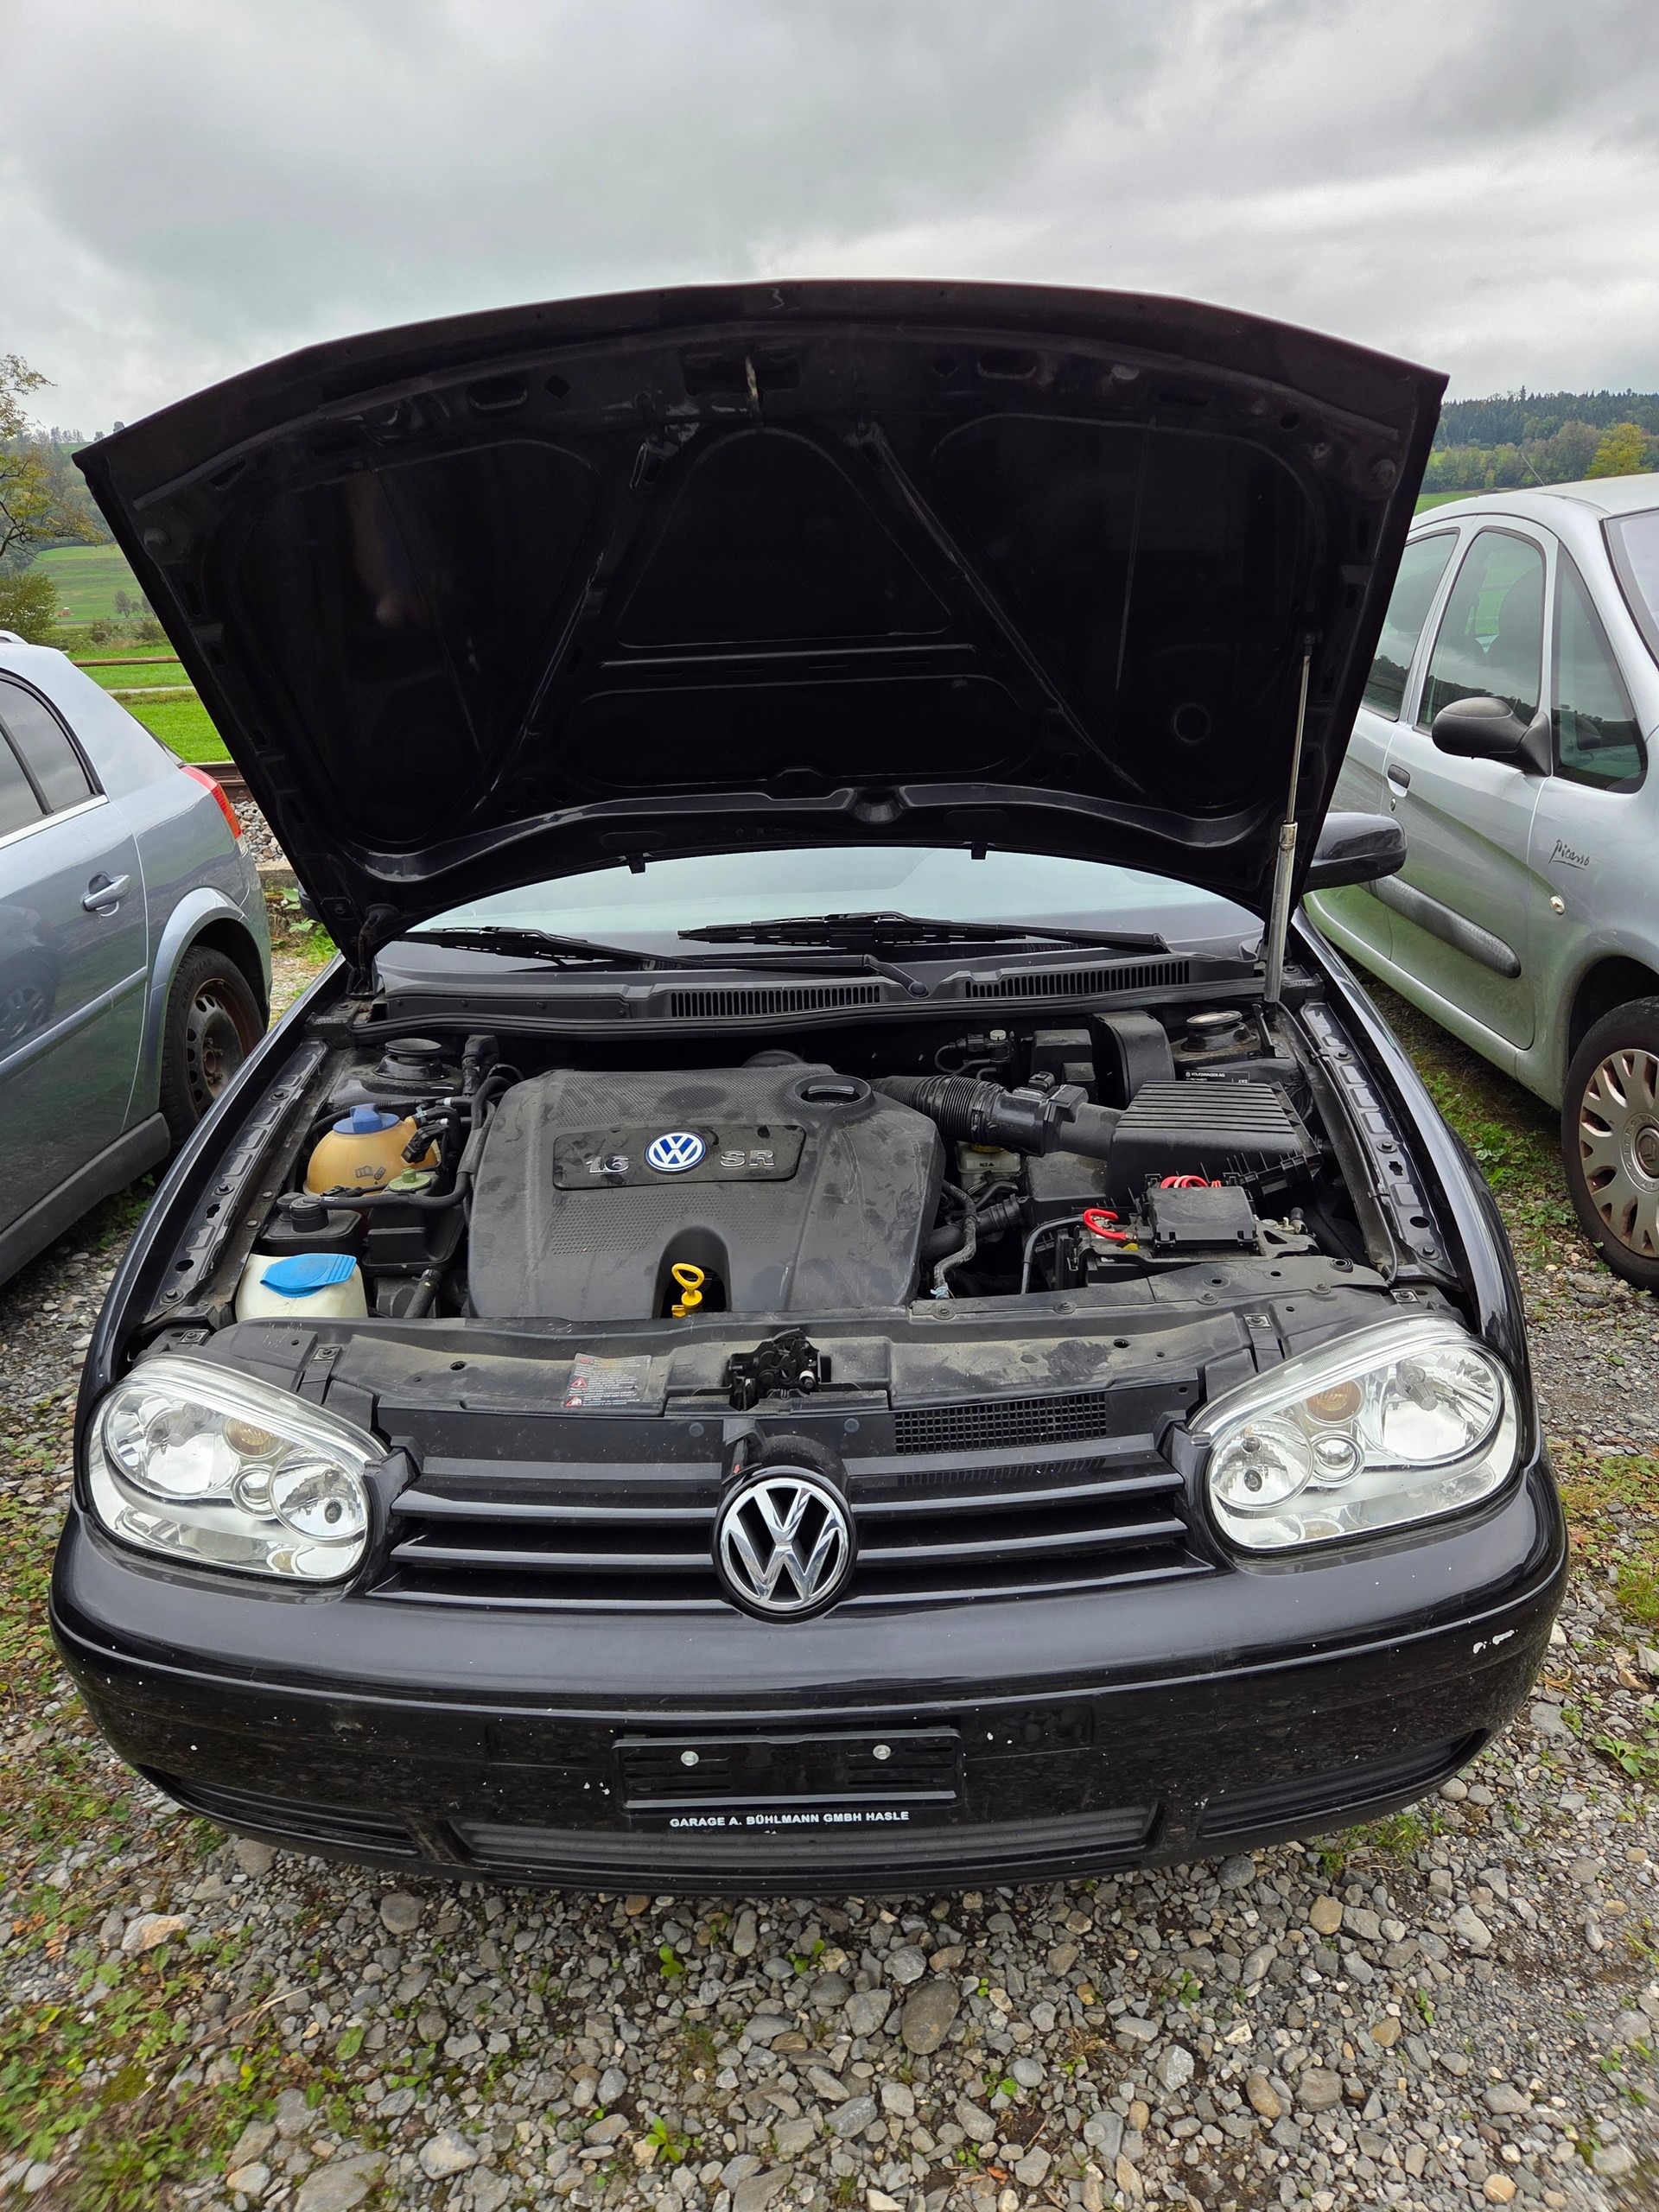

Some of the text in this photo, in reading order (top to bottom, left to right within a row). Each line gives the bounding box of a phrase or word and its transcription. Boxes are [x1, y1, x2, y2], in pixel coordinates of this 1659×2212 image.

[1548, 839, 1590, 867] Picasso
[720, 1149, 775, 1167] SR
[721, 1478, 849, 1611] VW
[670, 1812, 909, 1827] GARAGE A. BÜHLMANN GMBH HASLE
